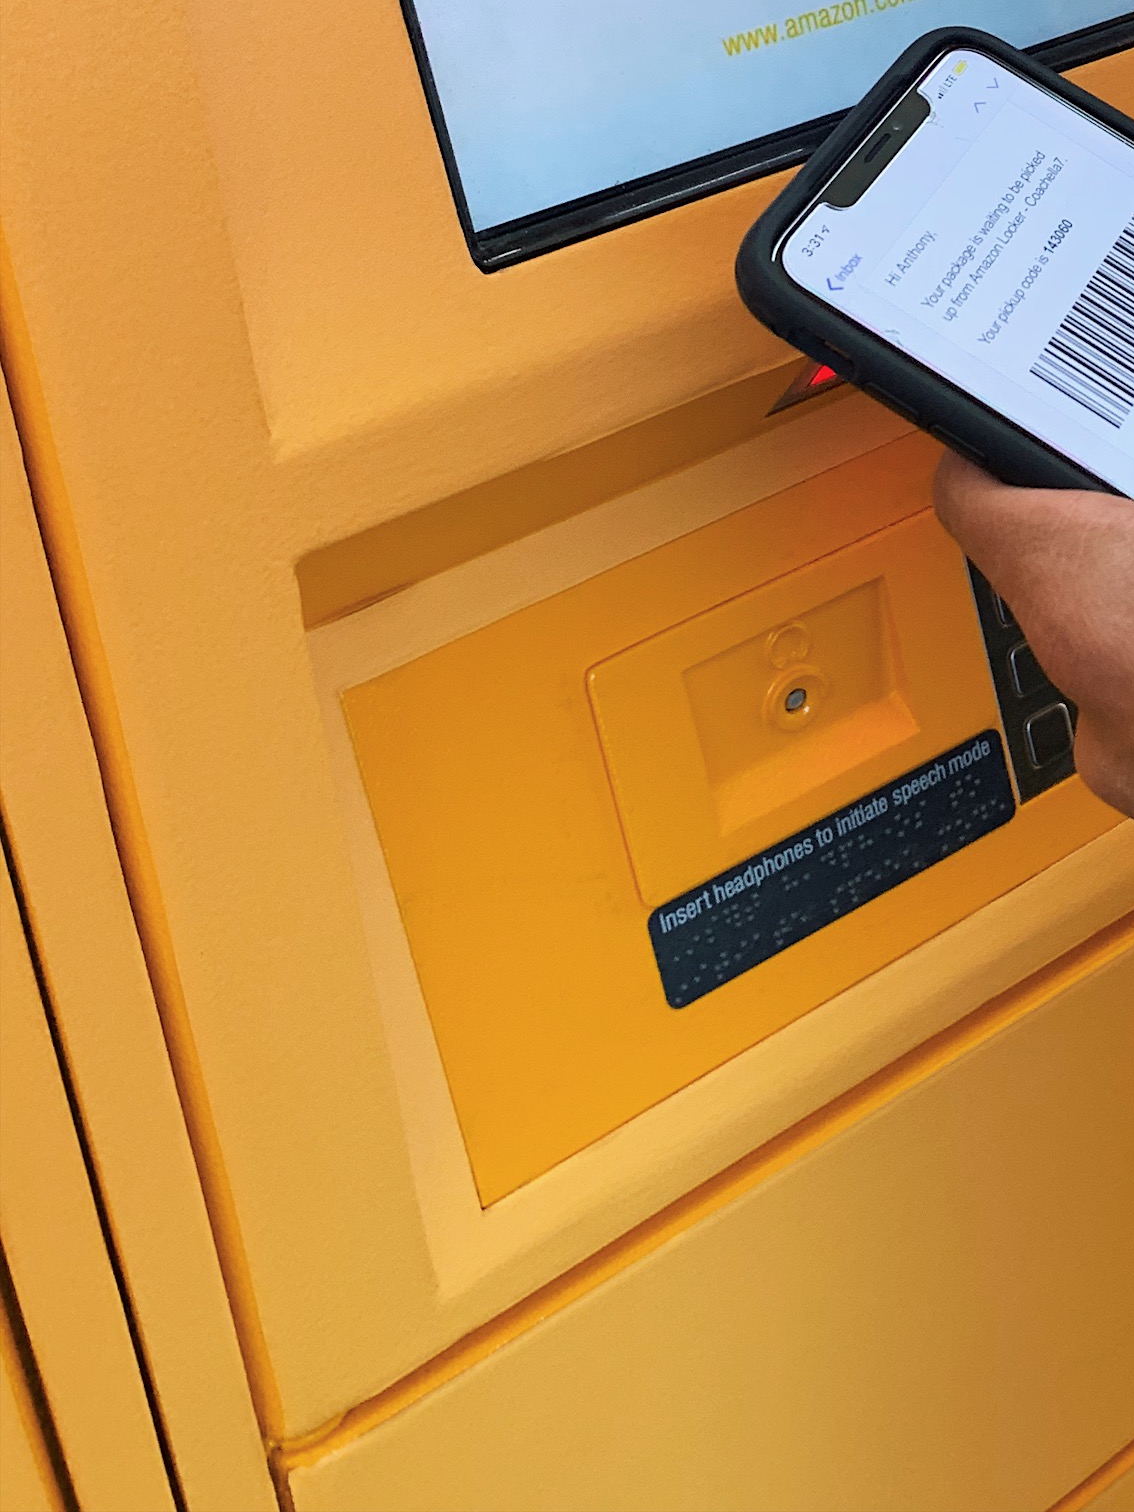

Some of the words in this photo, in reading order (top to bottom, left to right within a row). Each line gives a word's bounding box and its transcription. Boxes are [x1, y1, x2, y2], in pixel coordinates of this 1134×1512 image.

[943, 74, 958, 90] LTE
[801, 234, 825, 258] 3:31
[920, 284, 946, 309] Your
[942, 244, 976, 288] package
[971, 234, 984, 247] is
[979, 203, 1010, 236] waiting
[1001, 192, 1015, 204] to
[1008, 179, 1025, 195] be
[1020, 150, 1046, 182] picked
[1042, 219, 1073, 254] 143060
[835, 252, 863, 283] Inbox
[884, 269, 903, 287] Hi
[902, 230, 938, 273] Anthony,
[943, 305, 958, 322] up
[951, 282, 975, 307] from
[969, 242, 1004, 285] Amazon
[996, 213, 1027, 245] Locker
[1037, 253, 1049, 265] is
[1021, 264, 1043, 289] code
[998, 288, 1025, 325] pickup
[977, 319, 1001, 346] Your
[658, 892, 714, 934] Insert
[712, 835, 815, 906] headphones
[815, 825, 834, 848] to
[834, 794, 889, 837] initiate
[891, 762, 948, 808] speech
[947, 739, 993, 776] mode
